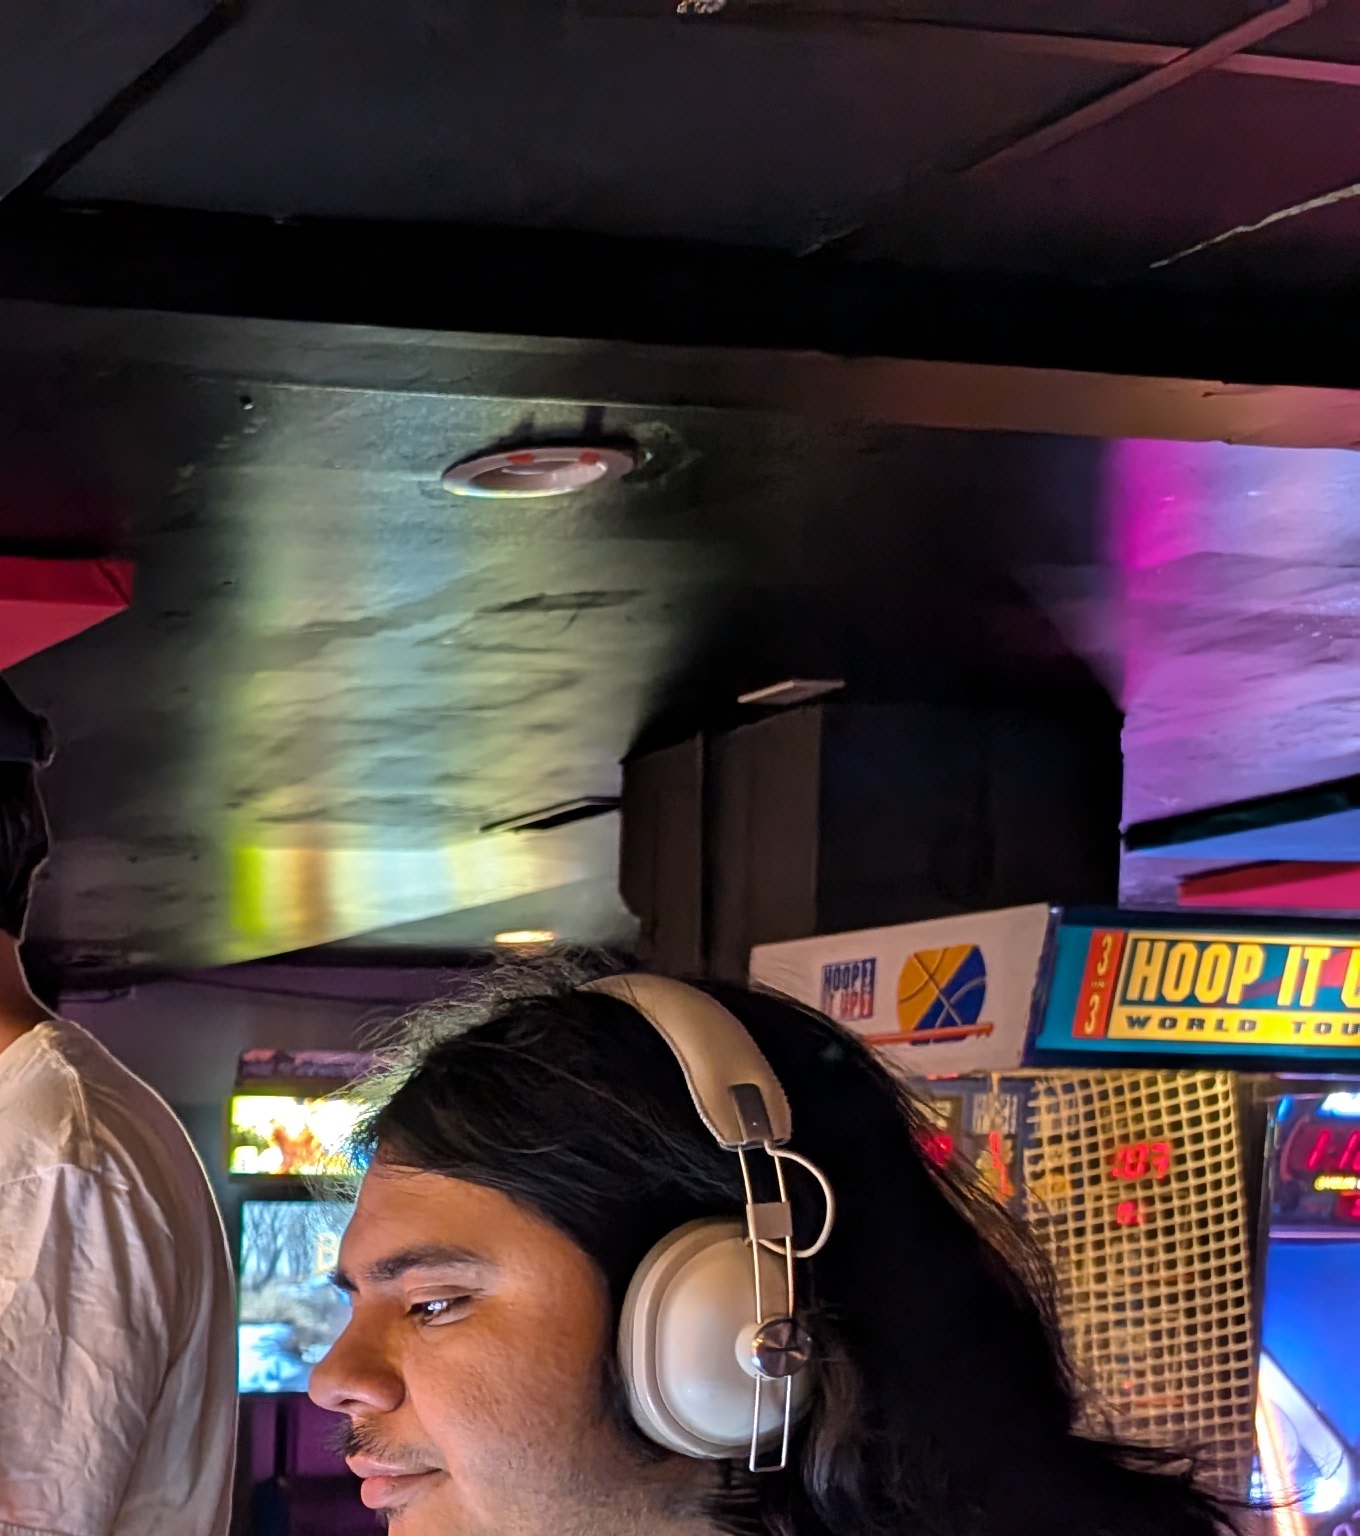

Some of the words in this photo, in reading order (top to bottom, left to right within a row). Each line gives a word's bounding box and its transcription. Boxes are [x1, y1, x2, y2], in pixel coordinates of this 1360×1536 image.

[1126, 939, 1265, 1005] HOOP
[1277, 945, 1331, 1007] IT
[1125, 1014, 1257, 1033] WORLD
